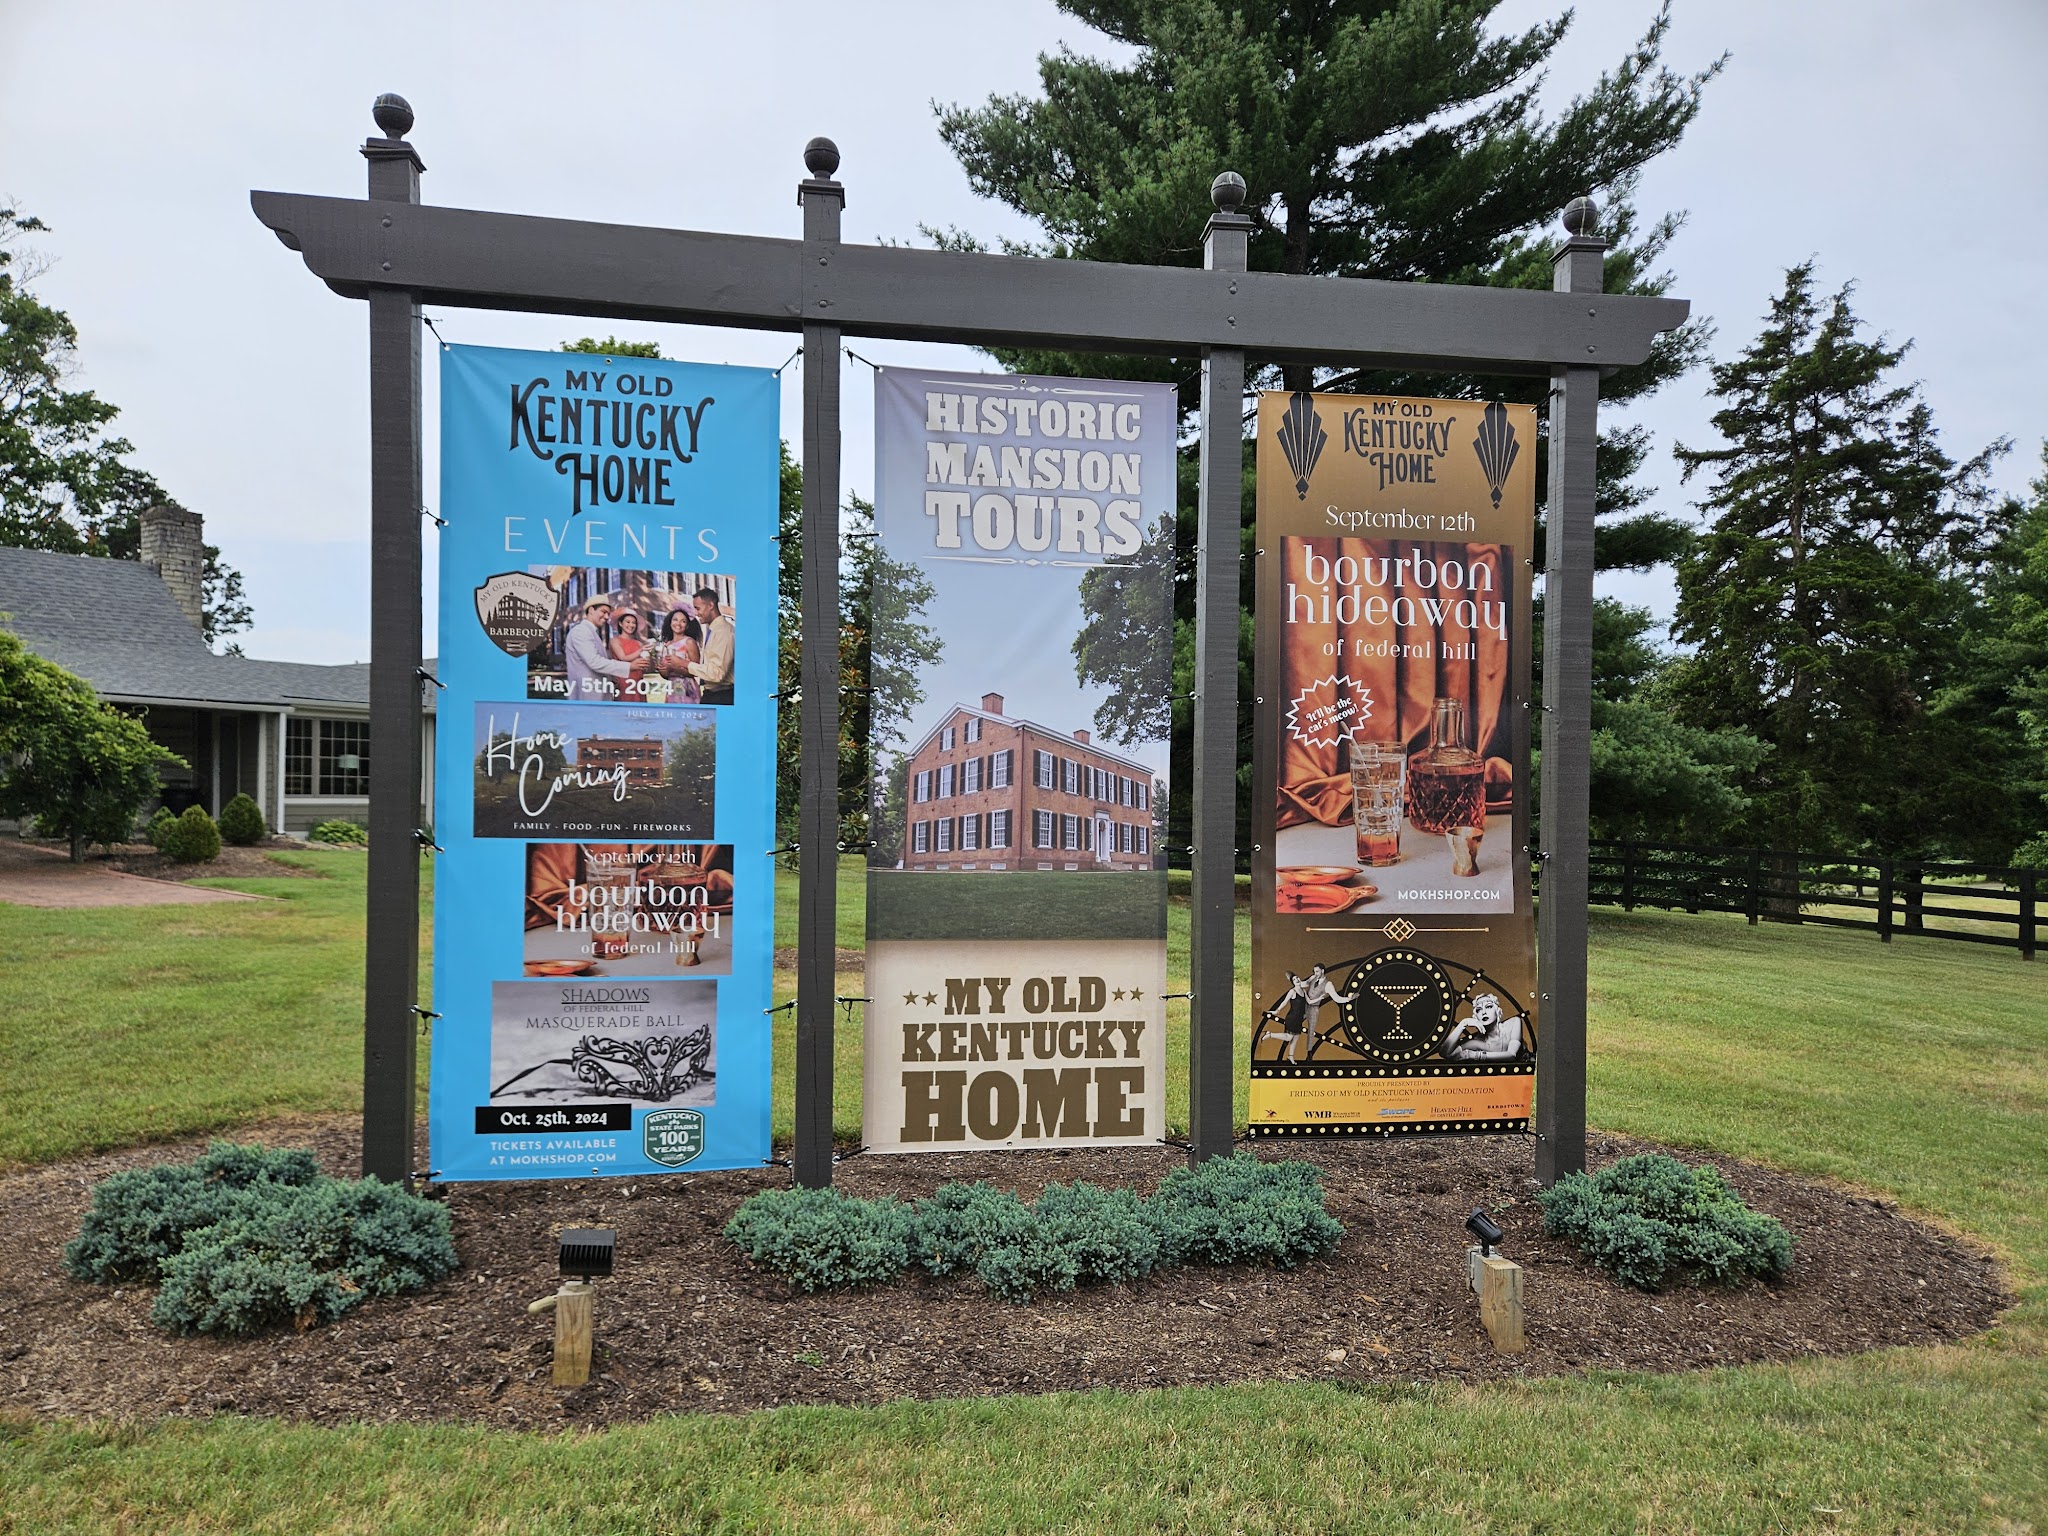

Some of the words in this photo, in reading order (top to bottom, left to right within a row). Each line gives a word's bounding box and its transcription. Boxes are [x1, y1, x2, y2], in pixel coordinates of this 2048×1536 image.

[566, 369, 607, 392] MY
[616, 374, 673, 397] OLD
[509, 377, 715, 464] KENTUCKY
[925, 392, 1141, 441] HISTORIC
[1373, 402, 1397, 416] MY
[1401, 403, 1433, 418] OLD
[1343, 407, 1457, 458] KENTUCKY
[926, 441, 1141, 495] MANSION
[1369, 452, 1437, 491] HOME
[555, 453, 675, 517] HOME
[925, 490, 1143, 556] TOURS
[1326, 504, 1435, 532] September
[1441, 511, 1475, 532] 12th
[504, 516, 719, 563] EVENTS
[1303, 544, 1493, 592] bourbon
[480, 590, 491, 602] MY
[492, 582, 508, 592] OLD
[511, 580, 555, 604] KENTUCKY
[1286, 583, 1508, 641] hideaway
[489, 627, 544, 638] BARBEQUE
[1322, 638, 1344, 657] of
[1355, 639, 1431, 659] federal
[1442, 642, 1477, 660] hill
[534, 675, 576, 697] May
[581, 676, 620, 697] 5th,
[625, 678, 674, 696] 2024
[627, 710, 650, 719] JULY
[681, 711, 703, 720] 2024
[1324, 705, 1337, 715] be
[1337, 697, 1352, 710] the
[1308, 718, 1329, 733] cat's
[1329, 703, 1360, 725] meow!
[486, 711, 573, 777] Home
[518, 754, 631, 817] Coming
[513, 822, 551, 831] FAMILY
[563, 823, 592, 831] FOOD
[633, 823, 692, 832] FIREWORKS
[584, 848, 665, 869] September
[669, 850, 696, 864] 12th
[568, 879, 709, 907] bourbon
[1398, 889, 1500, 900] MOKHSHOP.COM
[556, 905, 720, 939] hideaway
[581, 941, 596, 954] of
[604, 941, 661, 954] federal
[669, 941, 696, 954] hill
[561, 988, 650, 1002] SHADOWS
[944, 977, 1011, 1015] MY
[1022, 976, 1107, 1014] OLD
[563, 1005, 576, 1013] OF
[577, 1005, 622, 1013] FEDERAL
[624, 1004, 645, 1012] HILL
[526, 1015, 641, 1031] MASQUERADE
[646, 1014, 685, 1027] BALL
[902, 1020, 1145, 1062] KENTUCKY
[1353, 1089, 1370, 1097] OLD
[1372, 1088, 1415, 1096] KENTUCKY
[1416, 1088, 1441, 1096] HOME
[1442, 1087, 1495, 1095] FOUNDATION
[900, 1066, 1145, 1143] HOME
[1304, 1111, 1332, 1119] WMB
[500, 1112, 531, 1126] Oct.
[575, 1112, 607, 1126] 2024
[648, 1112, 699, 1124] KENTUCKY
[490, 1140, 541, 1151] TICKETS
[546, 1139, 616, 1150] AVAILABLE
[652, 1145, 696, 1153] YEARS
[659, 1130, 689, 1145] 100
[490, 1155, 507, 1166] AT
[510, 1153, 616, 1165] MOKHSHOP.COM
